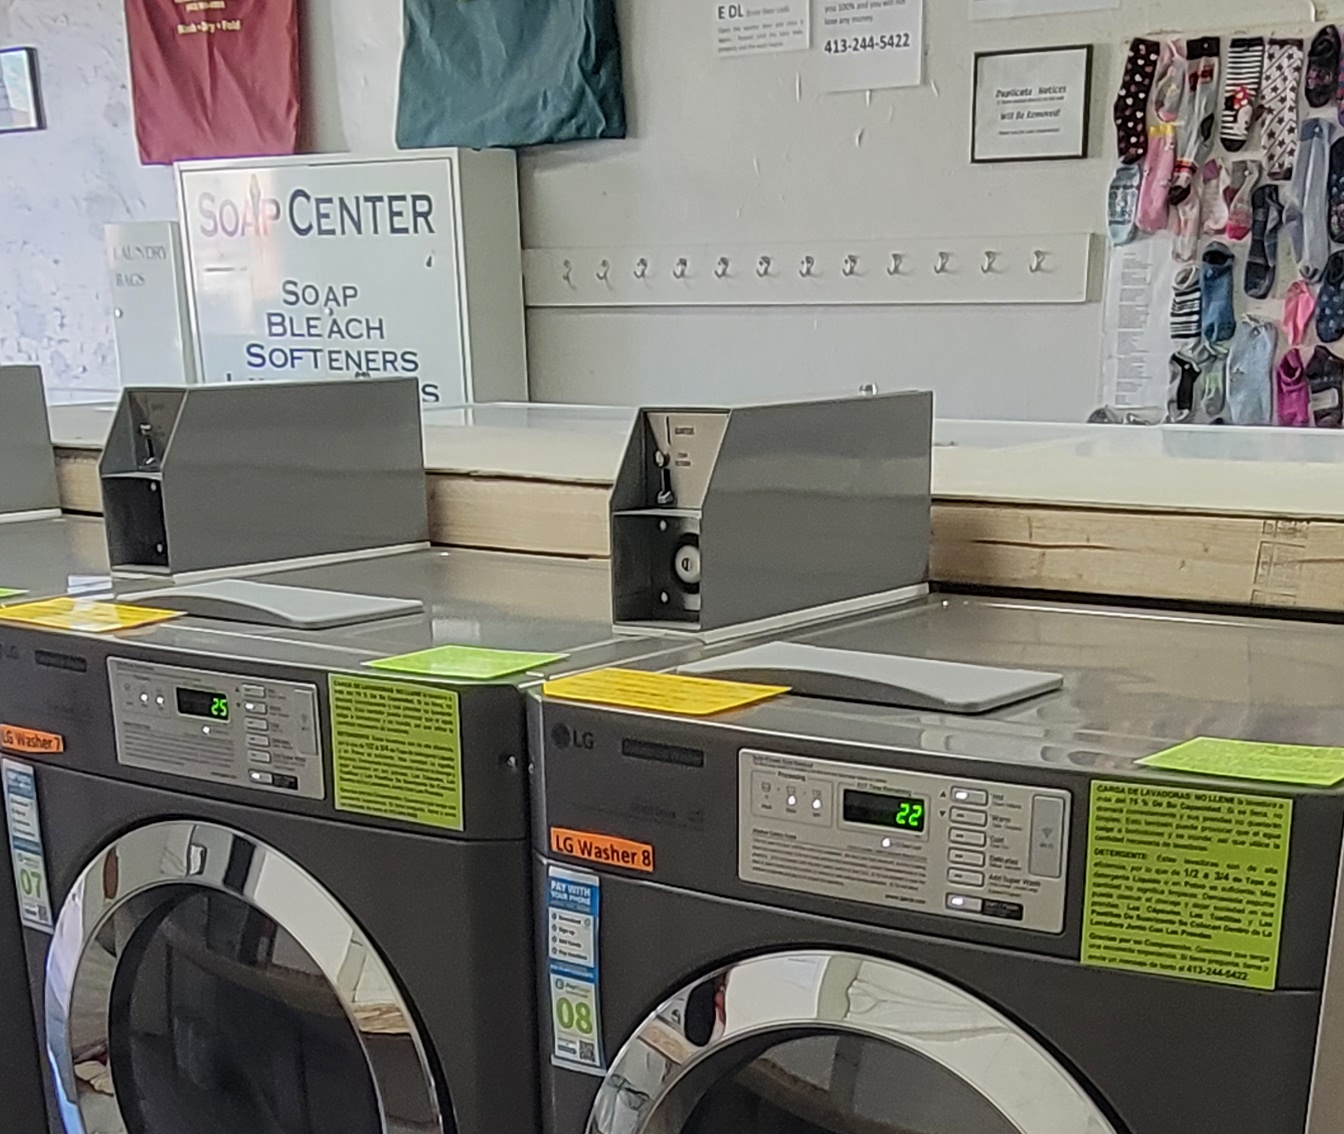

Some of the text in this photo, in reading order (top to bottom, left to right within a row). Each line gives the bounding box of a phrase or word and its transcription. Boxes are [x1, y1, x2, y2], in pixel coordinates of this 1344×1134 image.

[824, 32, 910, 54] 413-244-5422
[199, 189, 435, 237] SOAP CENTER
[282, 280, 358, 307] SOAP
[266, 312, 385, 339] BLEACH
[246, 343, 419, 372] SOFTENERS
[211, 697, 227, 716] 25
[16, 732, 53, 749] Washer
[54, 737, 61, 751] 7
[573, 729, 595, 749] LG
[1096, 783, 1125, 793] CARGA
[896, 803, 922, 827] 22
[555, 834, 652, 867] LG Washer 8
[20, 868, 42, 899] 07
[1183, 868, 1198, 878] 1/2
[551, 880, 591, 899] PAY WITH
[557, 997, 593, 1034] 08
